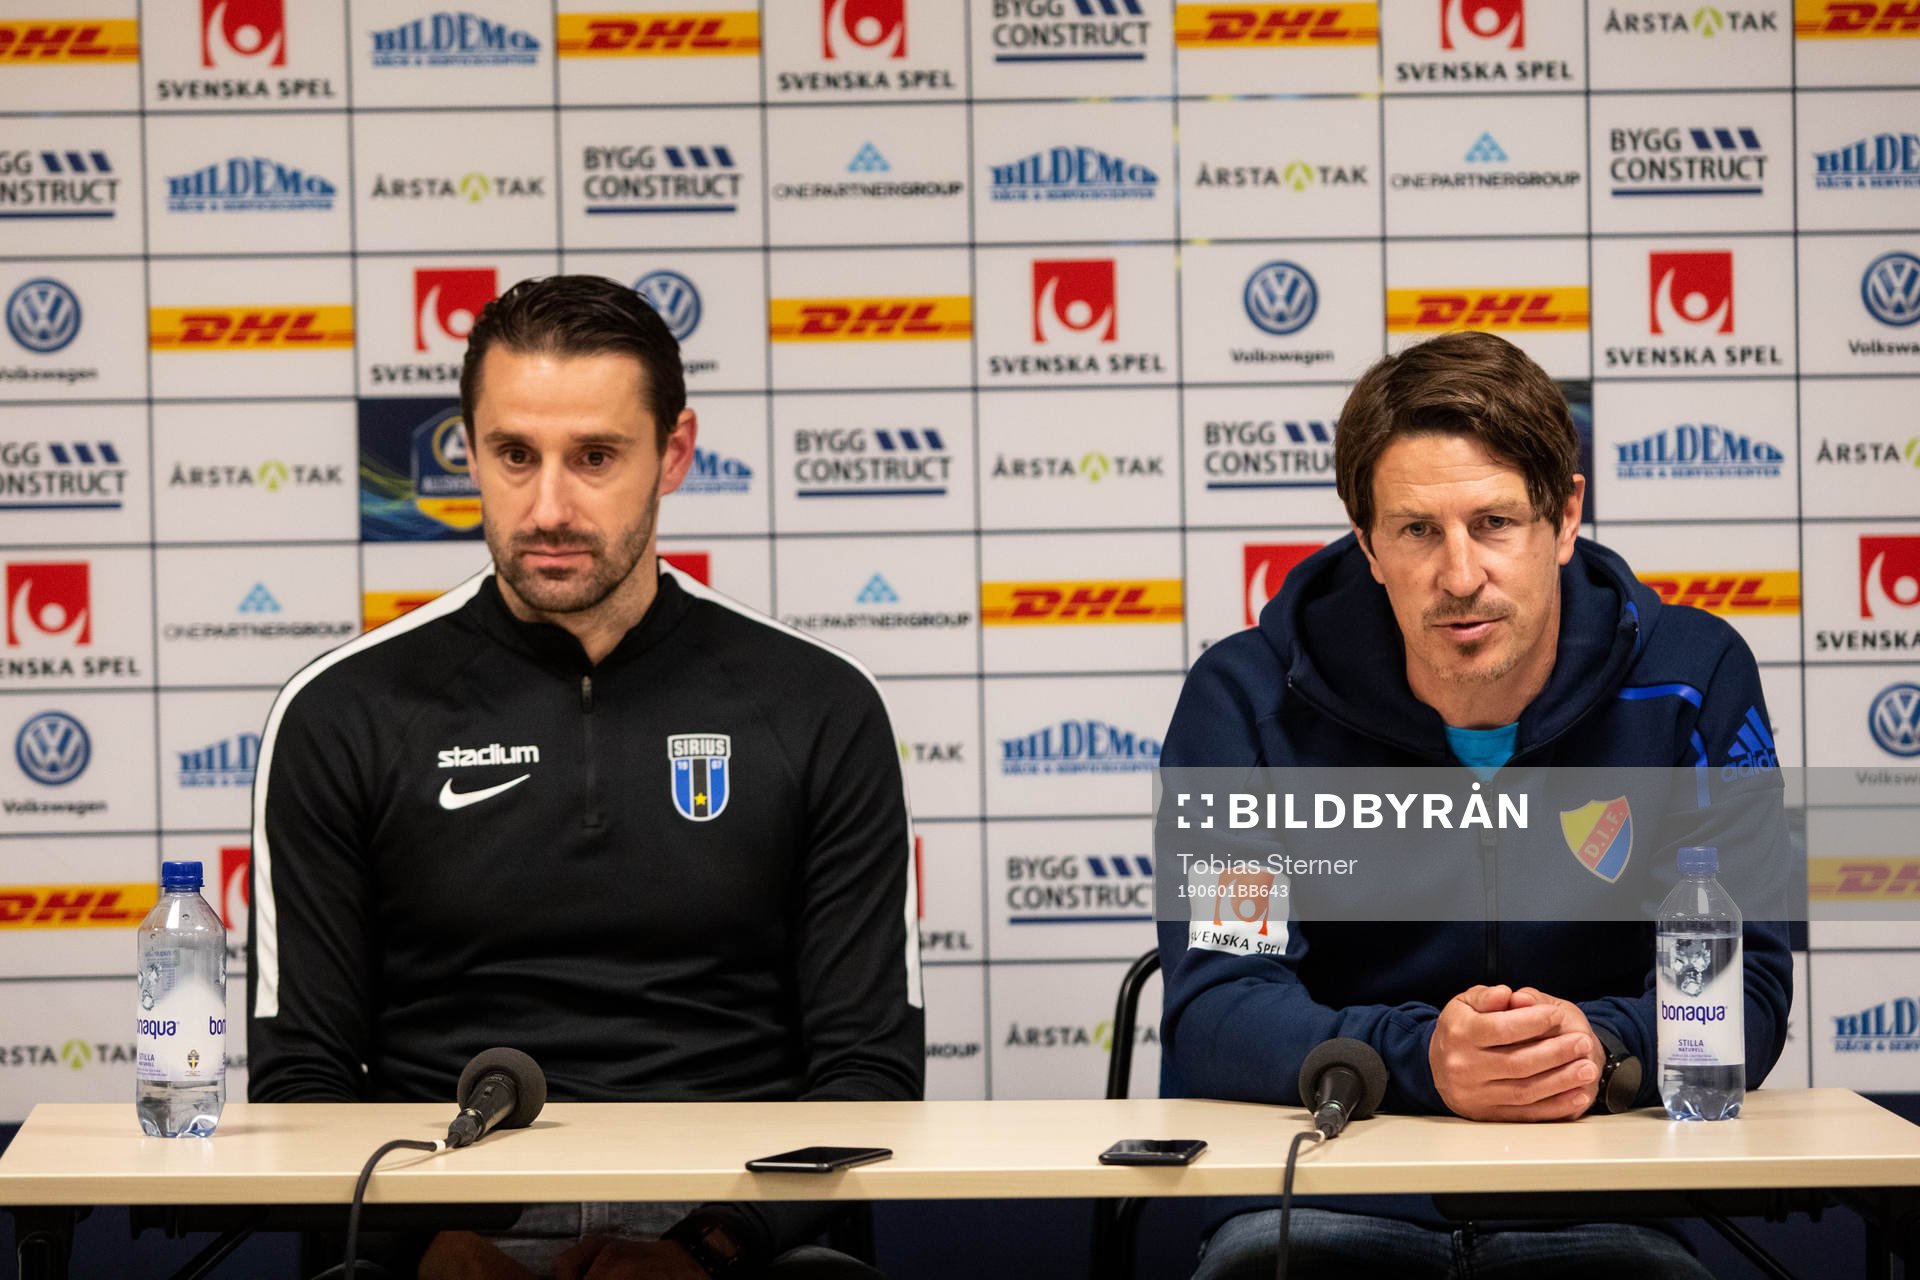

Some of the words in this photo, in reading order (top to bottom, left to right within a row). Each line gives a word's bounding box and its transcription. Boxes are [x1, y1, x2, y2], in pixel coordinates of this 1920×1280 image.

[1206, 11, 1348, 40] DHL
[1605, 9, 1689, 33] ÅRSTA
[1727, 12, 1777, 31] TAK
[588, 21, 730, 49] DHL
[993, 22, 1150, 48] CONSTRUCT
[778, 72, 889, 91] SVENSKA
[898, 70, 954, 89] SPEL
[1397, 62, 1507, 81] SVENSKA
[1516, 61, 1571, 80] SPEL
[157, 80, 269, 100] SVENSKA
[278, 79, 334, 98] SPEL
[1611, 128, 1681, 153] BYGG
[584, 146, 655, 170] BYGG
[1610, 156, 1767, 182] CONSTRUCT
[372, 176, 456, 198] ÅRSTA
[495, 178, 544, 195] TAK
[584, 174, 740, 200] CONSTRUCT
[1196, 164, 1280, 187] ÅRSTA
[1319, 166, 1367, 184] TAK
[1392, 172, 1581, 188] ONEPARTNERGROUP
[776, 182, 964, 199] ONEPARTNERGROUP
[800, 306, 941, 334] DHL
[1417, 296, 1559, 324] DHL
[181, 315, 323, 342] DHL
[990, 356, 1099, 374] SVENSKA
[1109, 354, 1162, 372] SPEL
[1232, 349, 1334, 365] Volkswagen
[1606, 348, 1716, 366] SVENSKA
[1726, 346, 1780, 364] SPEL
[795, 429, 866, 454] BYGG
[1205, 422, 1275, 446] BYGG
[1817, 440, 1900, 463] ÅRSTA
[170, 464, 254, 487] ÅRSTA
[294, 466, 341, 483] TAK
[795, 457, 950, 483] CONSTRUCT
[992, 456, 1075, 478] ÅRSTA
[1116, 458, 1162, 474] TAK
[0, 470, 125, 496] NSTRUCT
[1012, 589, 1152, 617] DHL
[0, 660, 73, 676] NSKA
[83, 658, 137, 676] SPEL
[438, 744, 539, 767] stadium
[673, 739, 726, 756] SIRIUS
[915, 744, 962, 762] TAK
[3, 800, 107, 816] Volkswagen
[1007, 856, 1078, 881] BYGG
[1191, 930, 1249, 950] SVENSKA
[1662, 1001, 1725, 1025] bonaqua
[1006, 1024, 1089, 1047] ÅRSTA
[1678, 1039, 1704, 1047] STILLA
